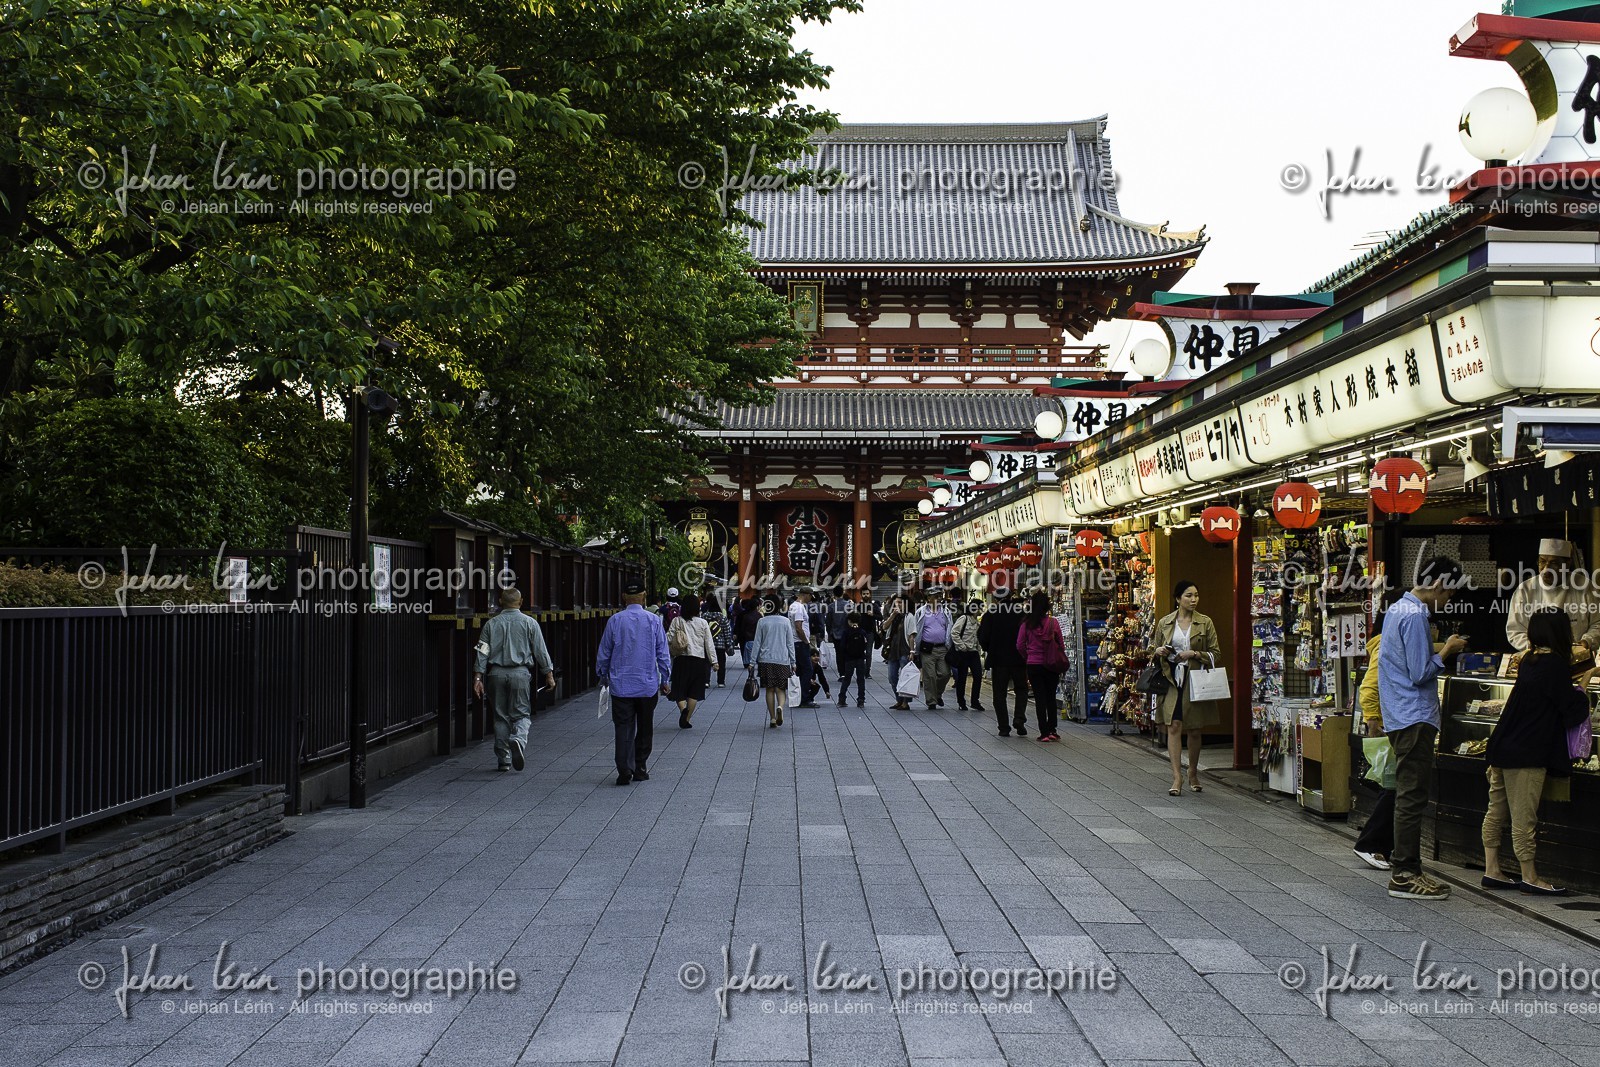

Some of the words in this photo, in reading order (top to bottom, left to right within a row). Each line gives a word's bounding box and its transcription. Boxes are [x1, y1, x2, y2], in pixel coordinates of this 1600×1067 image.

[1447, 335, 1479, 358] のれん会
[1451, 358, 1484, 383] うまいもの会
